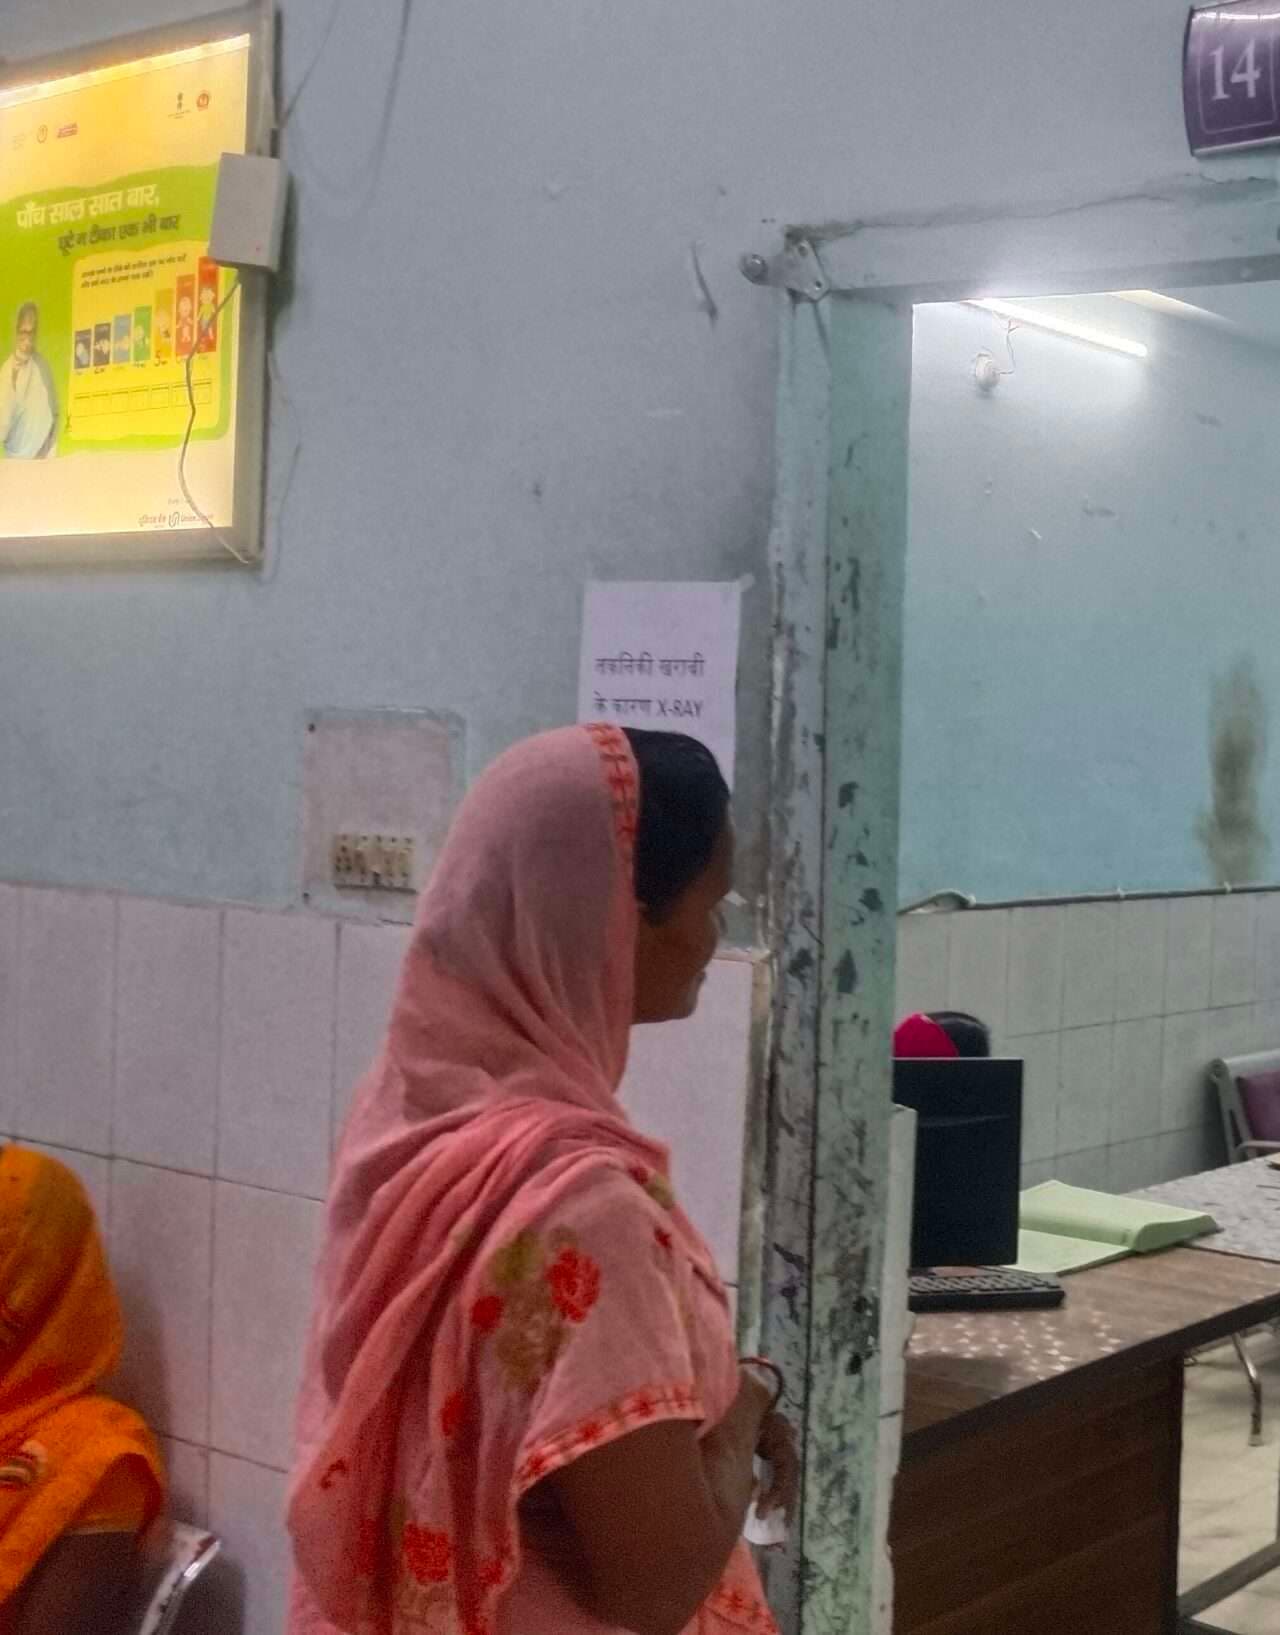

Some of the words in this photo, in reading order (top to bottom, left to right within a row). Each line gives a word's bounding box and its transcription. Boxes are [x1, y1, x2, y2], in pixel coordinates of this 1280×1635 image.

[1211, 44, 1260, 100] 14
[49, 199, 85, 224] साल
[659, 652, 706, 676] खराबी
[594, 690, 608, 713] के
[611, 698, 652, 716] कारण
[657, 699, 704, 718] X-RAY
